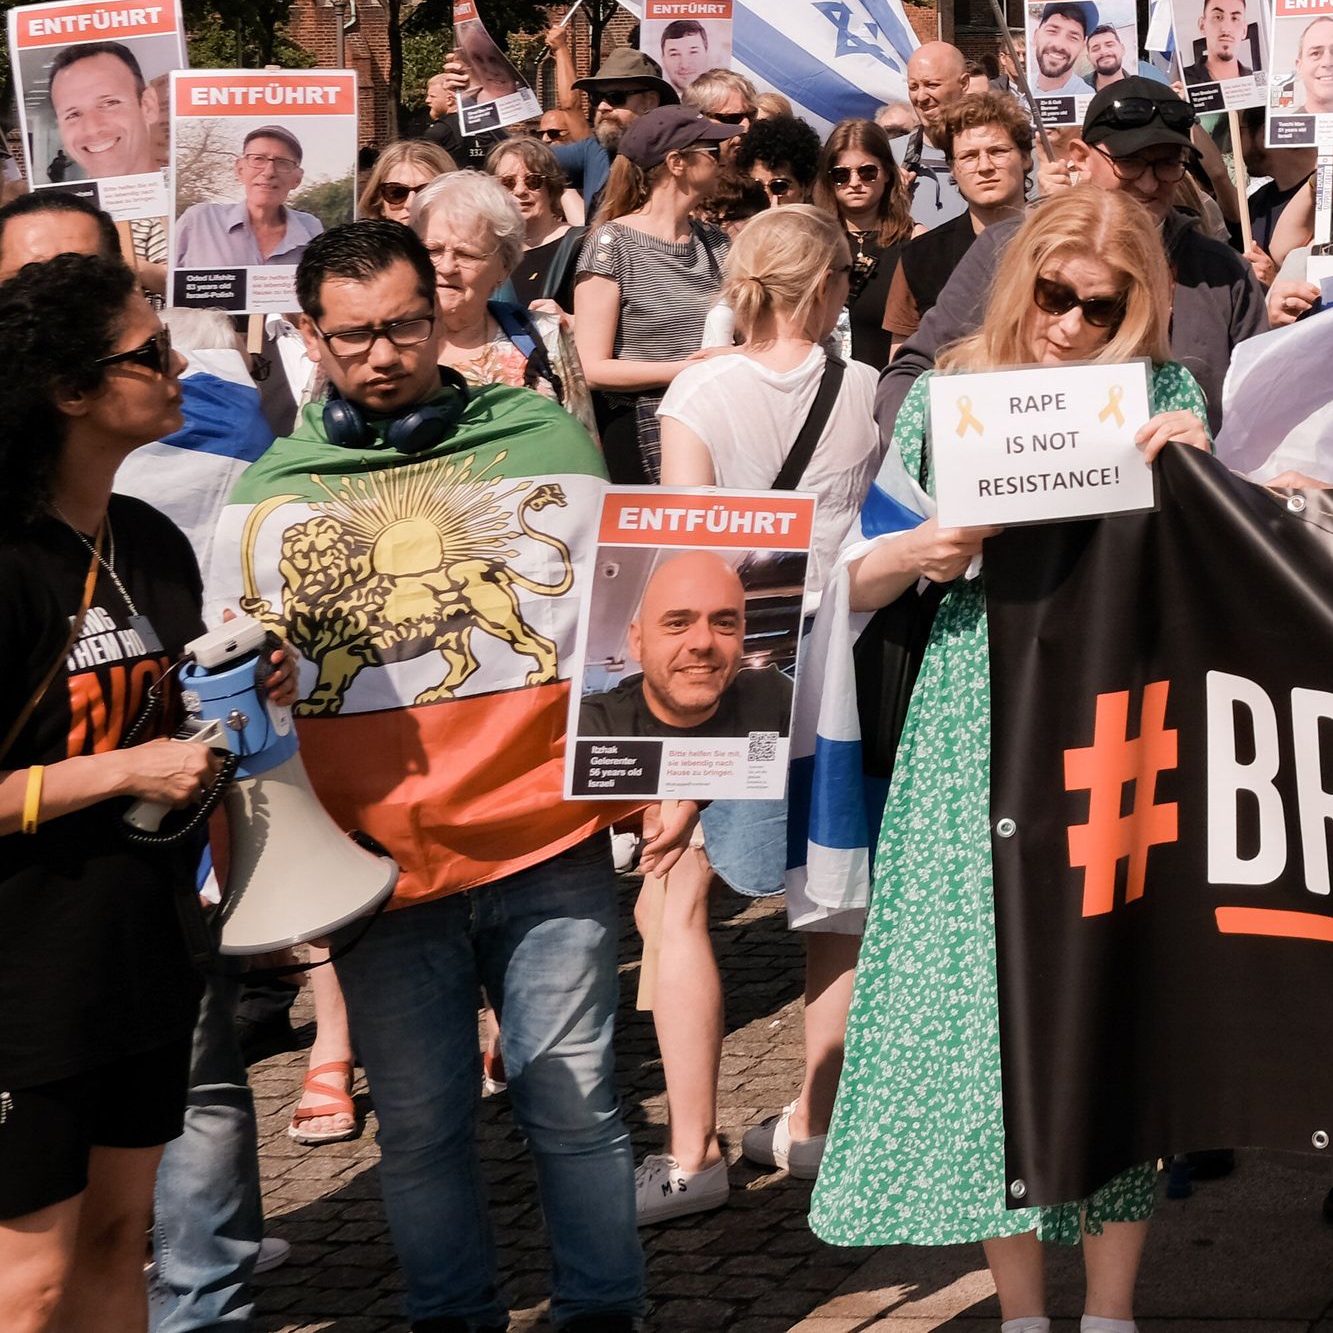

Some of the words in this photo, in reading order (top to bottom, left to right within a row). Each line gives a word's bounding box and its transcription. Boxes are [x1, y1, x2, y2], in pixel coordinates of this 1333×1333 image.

[653, 2, 726, 14] ENTFÜHRT
[28, 6, 163, 37] ENTFÜHRT
[190, 83, 341, 106] ENTFÜHRT
[196, 284, 219, 292] years
[1009, 393, 1067, 415] RAPE
[1006, 436, 1025, 454] IS
[1032, 431, 1080, 452] NOT
[978, 466, 1121, 498] RESISTANCE!
[617, 505, 798, 535] ENTFÜHRT
[591, 745, 618, 754] Itzhak
[588, 779, 615, 788] Israeli
[589, 768, 600, 776] 56
[601, 769, 626, 778] years
[627, 768, 643, 776] old
